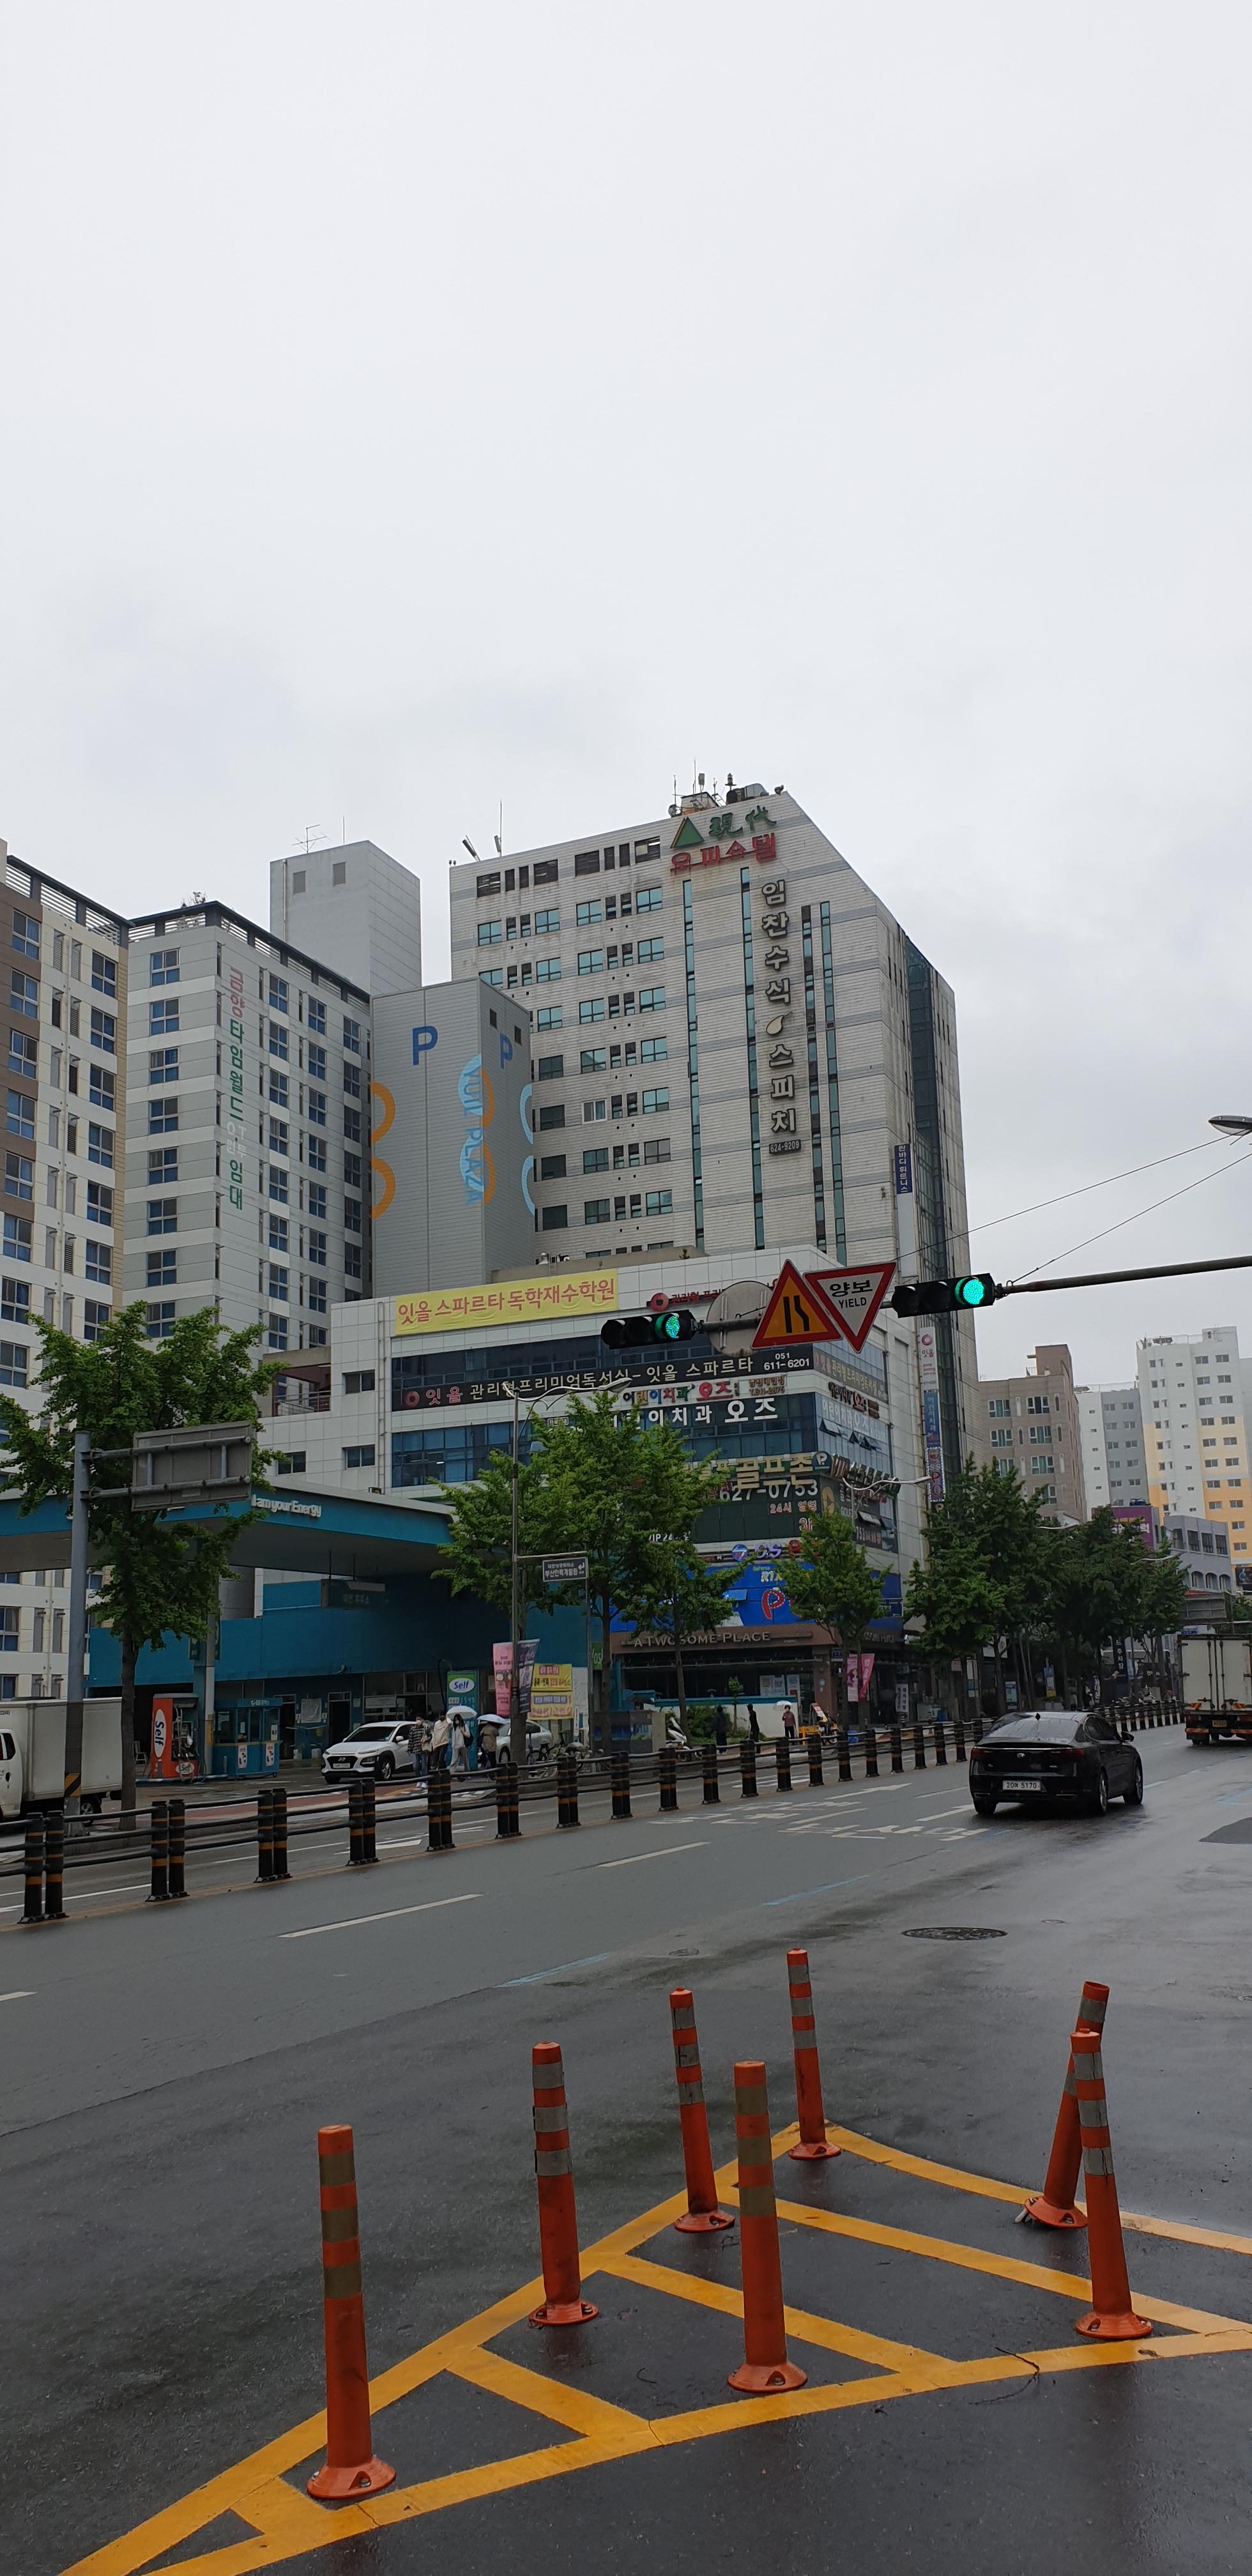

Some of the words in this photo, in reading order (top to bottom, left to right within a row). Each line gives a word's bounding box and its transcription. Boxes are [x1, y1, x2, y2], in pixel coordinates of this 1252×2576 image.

[708, 805, 777, 839] 現代
[670, 832, 777, 873] 오피스텔
[412, 1025, 438, 1066] P
[500, 1032, 513, 1070] P
[768, 1044, 797, 1133] 스피치
[770, 1140, 801, 1153] 624-9209
[229, 1160, 243, 1210] 임대
[435, 1292, 505, 1317] 스파르타
[507, 1278, 615, 1311] 독학재수학원
[830, 1279, 873, 1297] 양보
[838, 1298, 867, 1308] YIELD
[685, 1356, 753, 1378] 스파르타
[764, 1358, 810, 1371] 611-6201
[775, 1352, 790, 1360] 051
[697, 1382, 733, 1402] 오즈
[725, 1398, 777, 1423] 오즈
[736, 1452, 814, 1489] 골프존
[256, 1498, 270, 1508] am
[271, 1501, 291, 1512] your
[292, 1501, 321, 1517] Energy
[770, 1502, 792, 1514] 24시
[722, 1632, 771, 1643] PLACE
[454, 1680, 469, 1689] Self
[155, 1721, 164, 1746] Self
